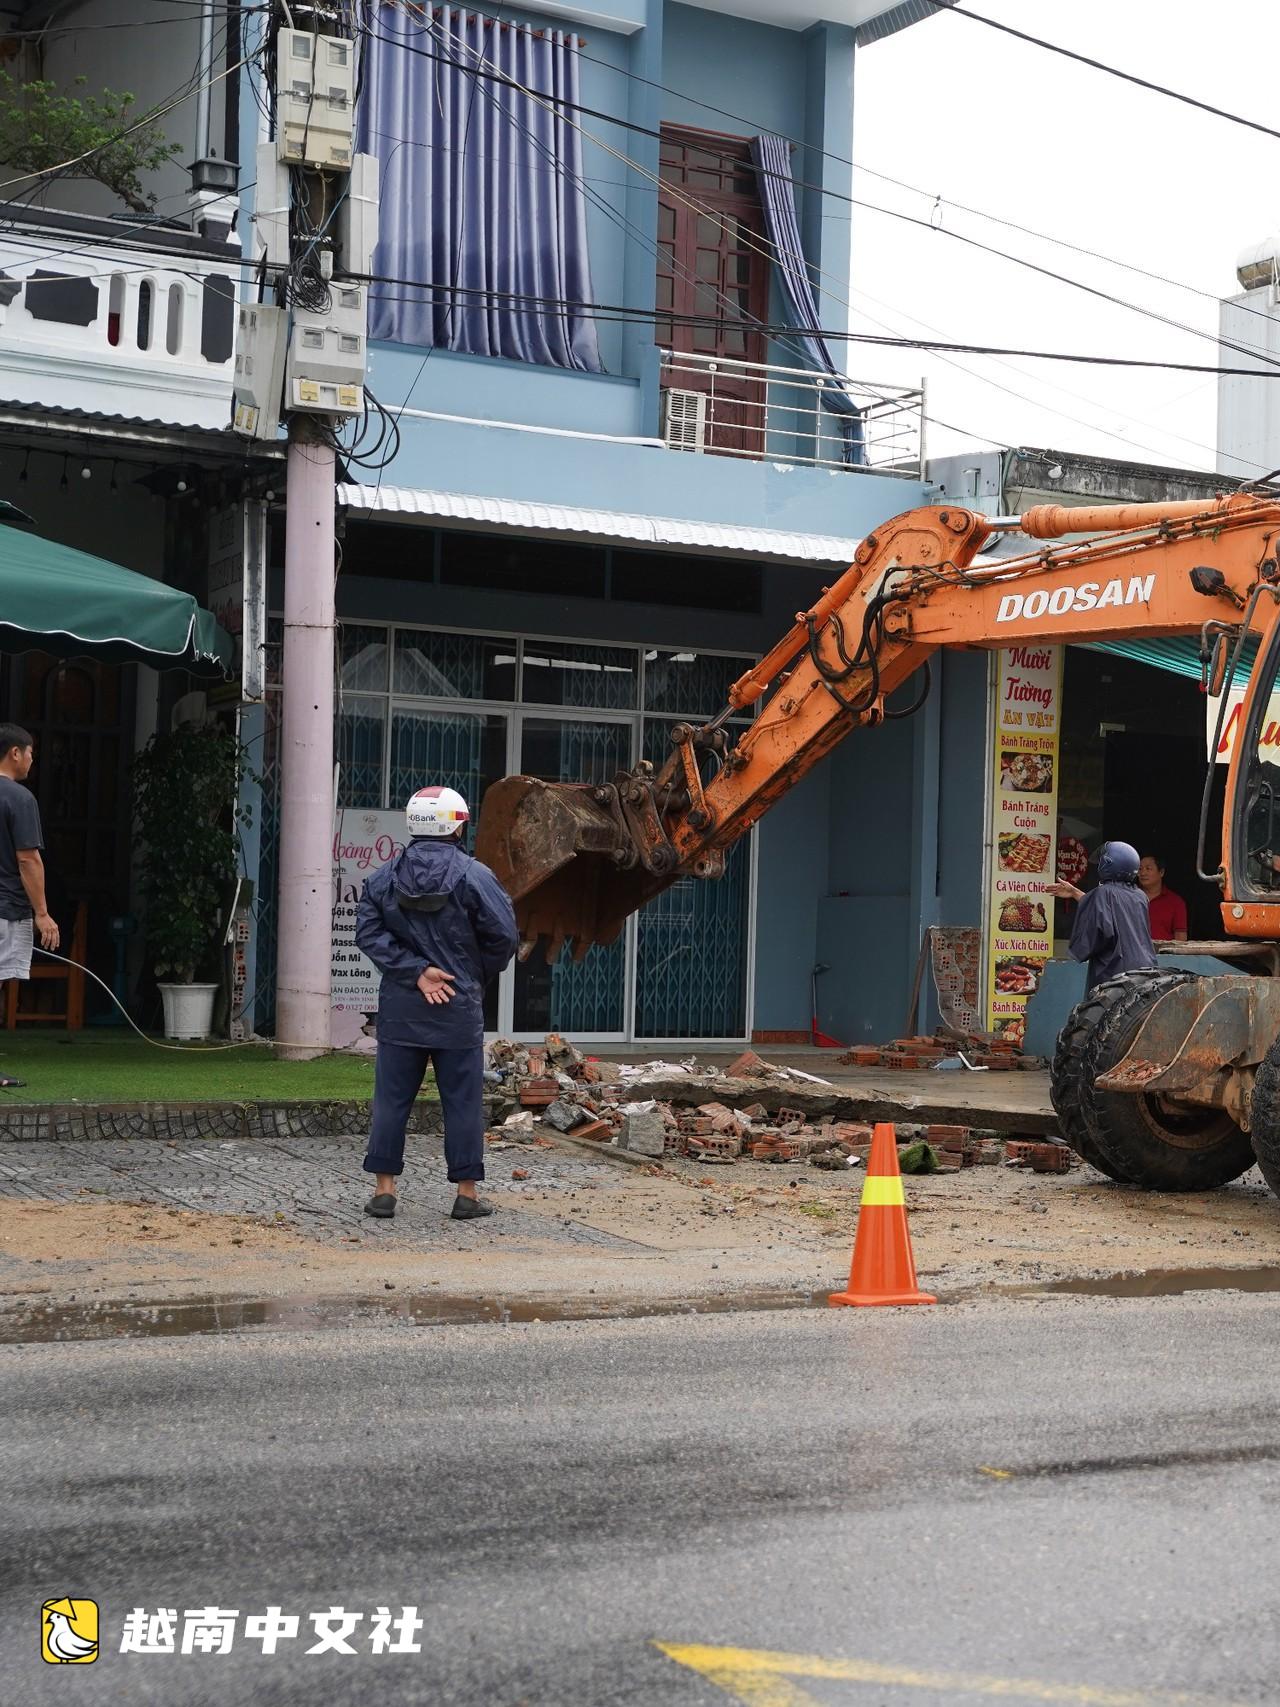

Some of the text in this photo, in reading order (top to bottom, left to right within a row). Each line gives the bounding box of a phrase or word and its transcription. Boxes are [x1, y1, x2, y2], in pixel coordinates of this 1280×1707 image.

[996, 574, 1157, 622] DOOSAN
[1008, 646, 1052, 670] Mười
[1001, 735, 1017, 748] Bánh
[1039, 737, 1054, 753] Trộn
[1002, 800, 1049, 816] Bánh Tráng
[1014, 816, 1036, 830] Cuộn
[996, 880, 1047, 893] Cá Viên Chiê
[995, 939, 1049, 951] Xúc Xích Chiên
[350, 969, 371, 979] Lông
[992, 1001, 1010, 1012] Bánh
